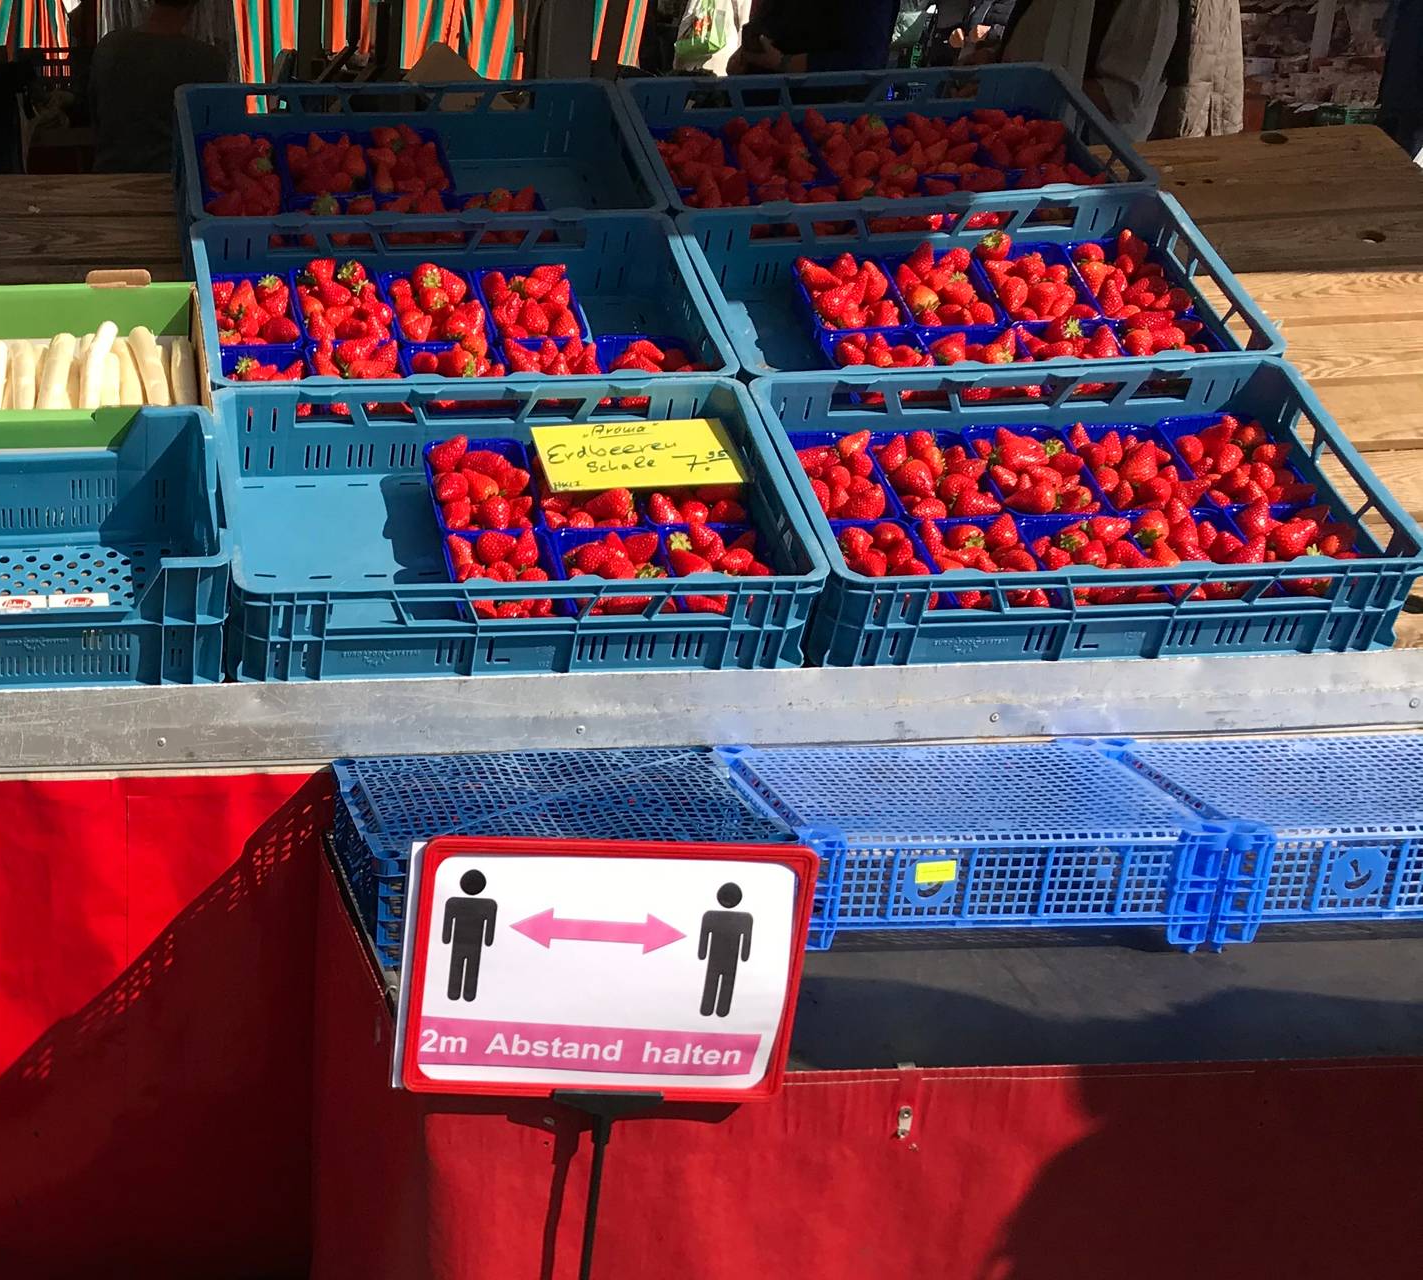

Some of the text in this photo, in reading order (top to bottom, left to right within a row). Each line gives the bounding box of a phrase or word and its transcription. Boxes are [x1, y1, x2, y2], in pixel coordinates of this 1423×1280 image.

[547, 441, 677, 464] Erdbeeren
[586, 456, 657, 473] Schale
[420, 1030, 741, 1065] 2m Abstand halten
